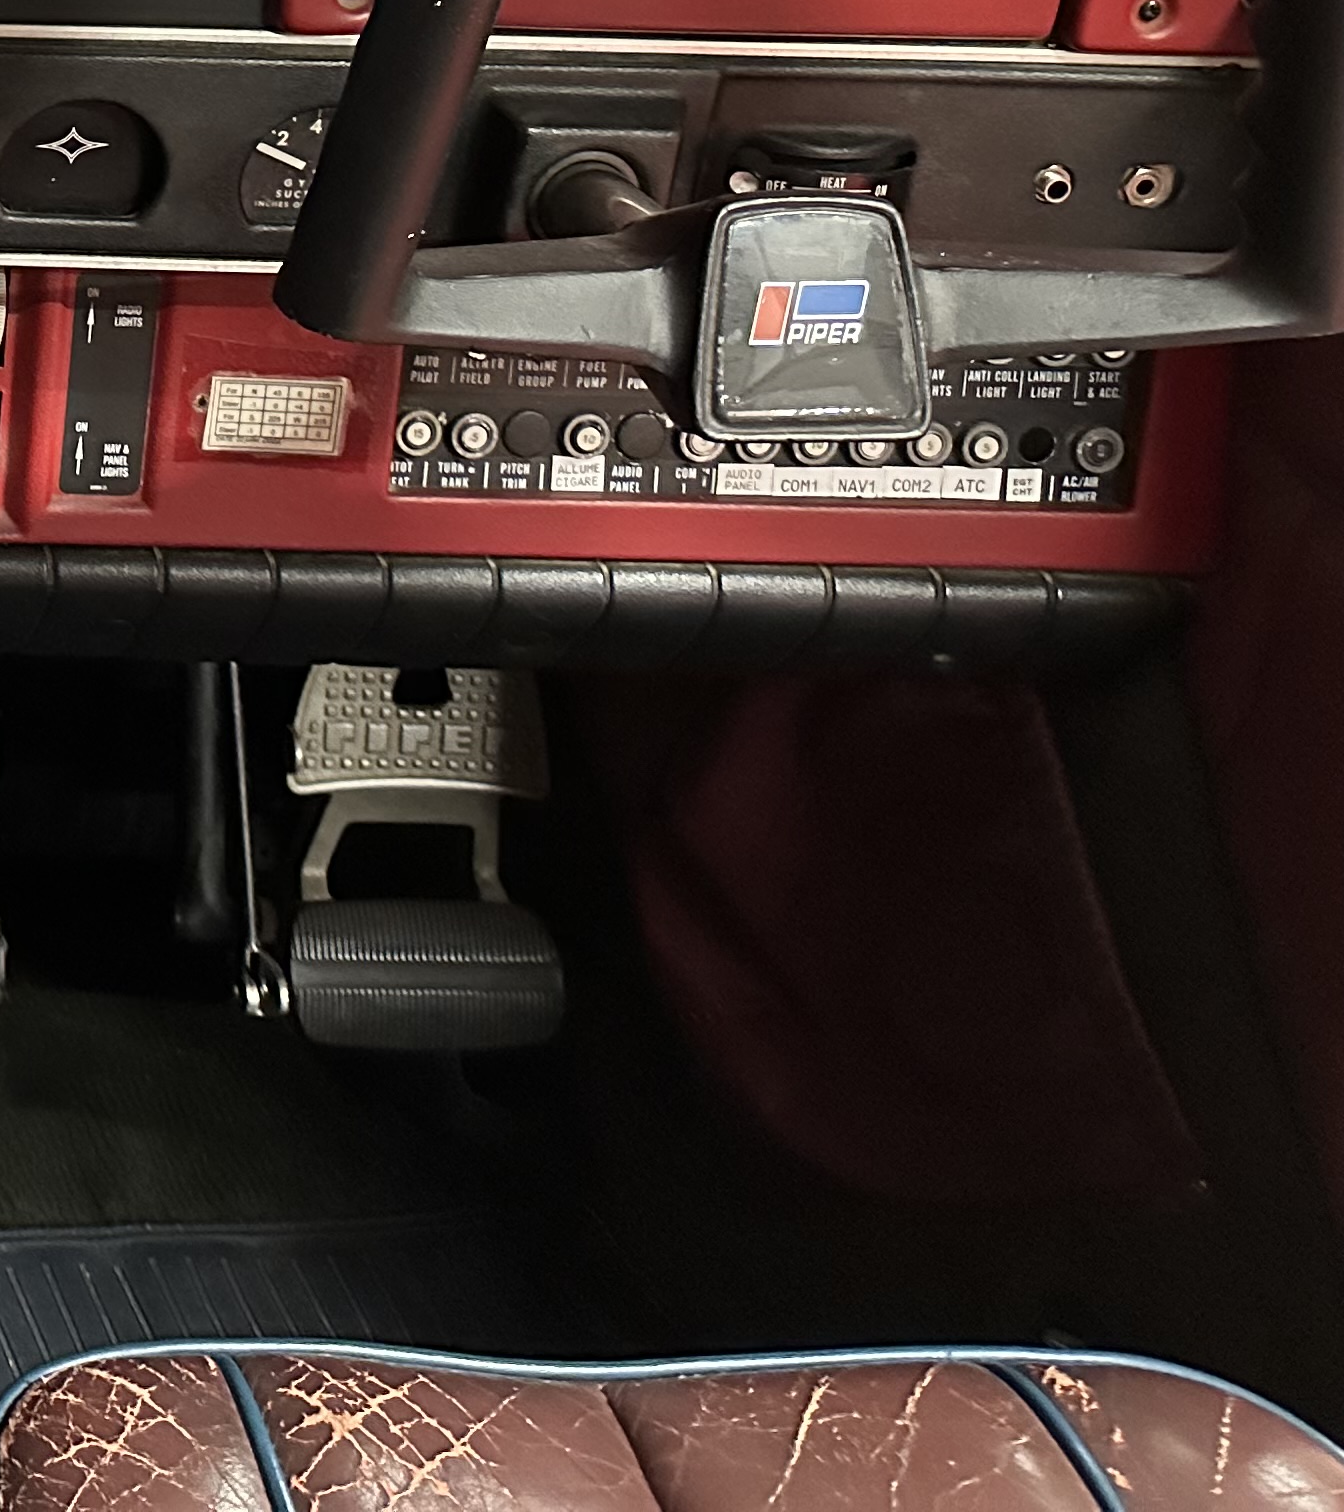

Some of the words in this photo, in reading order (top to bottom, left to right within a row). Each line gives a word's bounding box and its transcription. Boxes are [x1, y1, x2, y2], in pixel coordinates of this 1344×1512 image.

[820, 177, 847, 188] HEAT
[875, 185, 887, 196] ON
[115, 317, 143, 328] LIGHTS
[787, 323, 862, 345] PIPER
[413, 356, 440, 368] AUTO
[580, 360, 606, 372] FUEL
[410, 370, 440, 383] PILOT
[460, 371, 490, 384] FIELD
[518, 374, 554, 387] GROUP
[577, 376, 608, 388] PUMP
[968, 371, 992, 382] ANTI
[995, 371, 1018, 382] COLL
[1028, 371, 1070, 382] LANDING
[1089, 373, 1120, 383] START
[976, 387, 1007, 398] LIGHT
[1031, 387, 1062, 398] LIGHT
[76, 422, 88, 432] ON
[103, 455, 128, 466] PANEL
[100, 466, 129, 478] LIGHTS
[500, 462, 530, 474] PITCH
[558, 464, 600, 474] ALLUME
[612, 466, 642, 478] AUDIO
[726, 469, 761, 479] AUDIO
[502, 477, 527, 489] TRIM
[555, 475, 598, 487] CIGARE
[610, 481, 640, 493] PANEL
[725, 480, 760, 491] PANEL
[781, 479, 817, 492] COM1
[838, 479, 875, 492] NAV1
[892, 479, 931, 492] COM2
[954, 479, 985, 492] ATC
